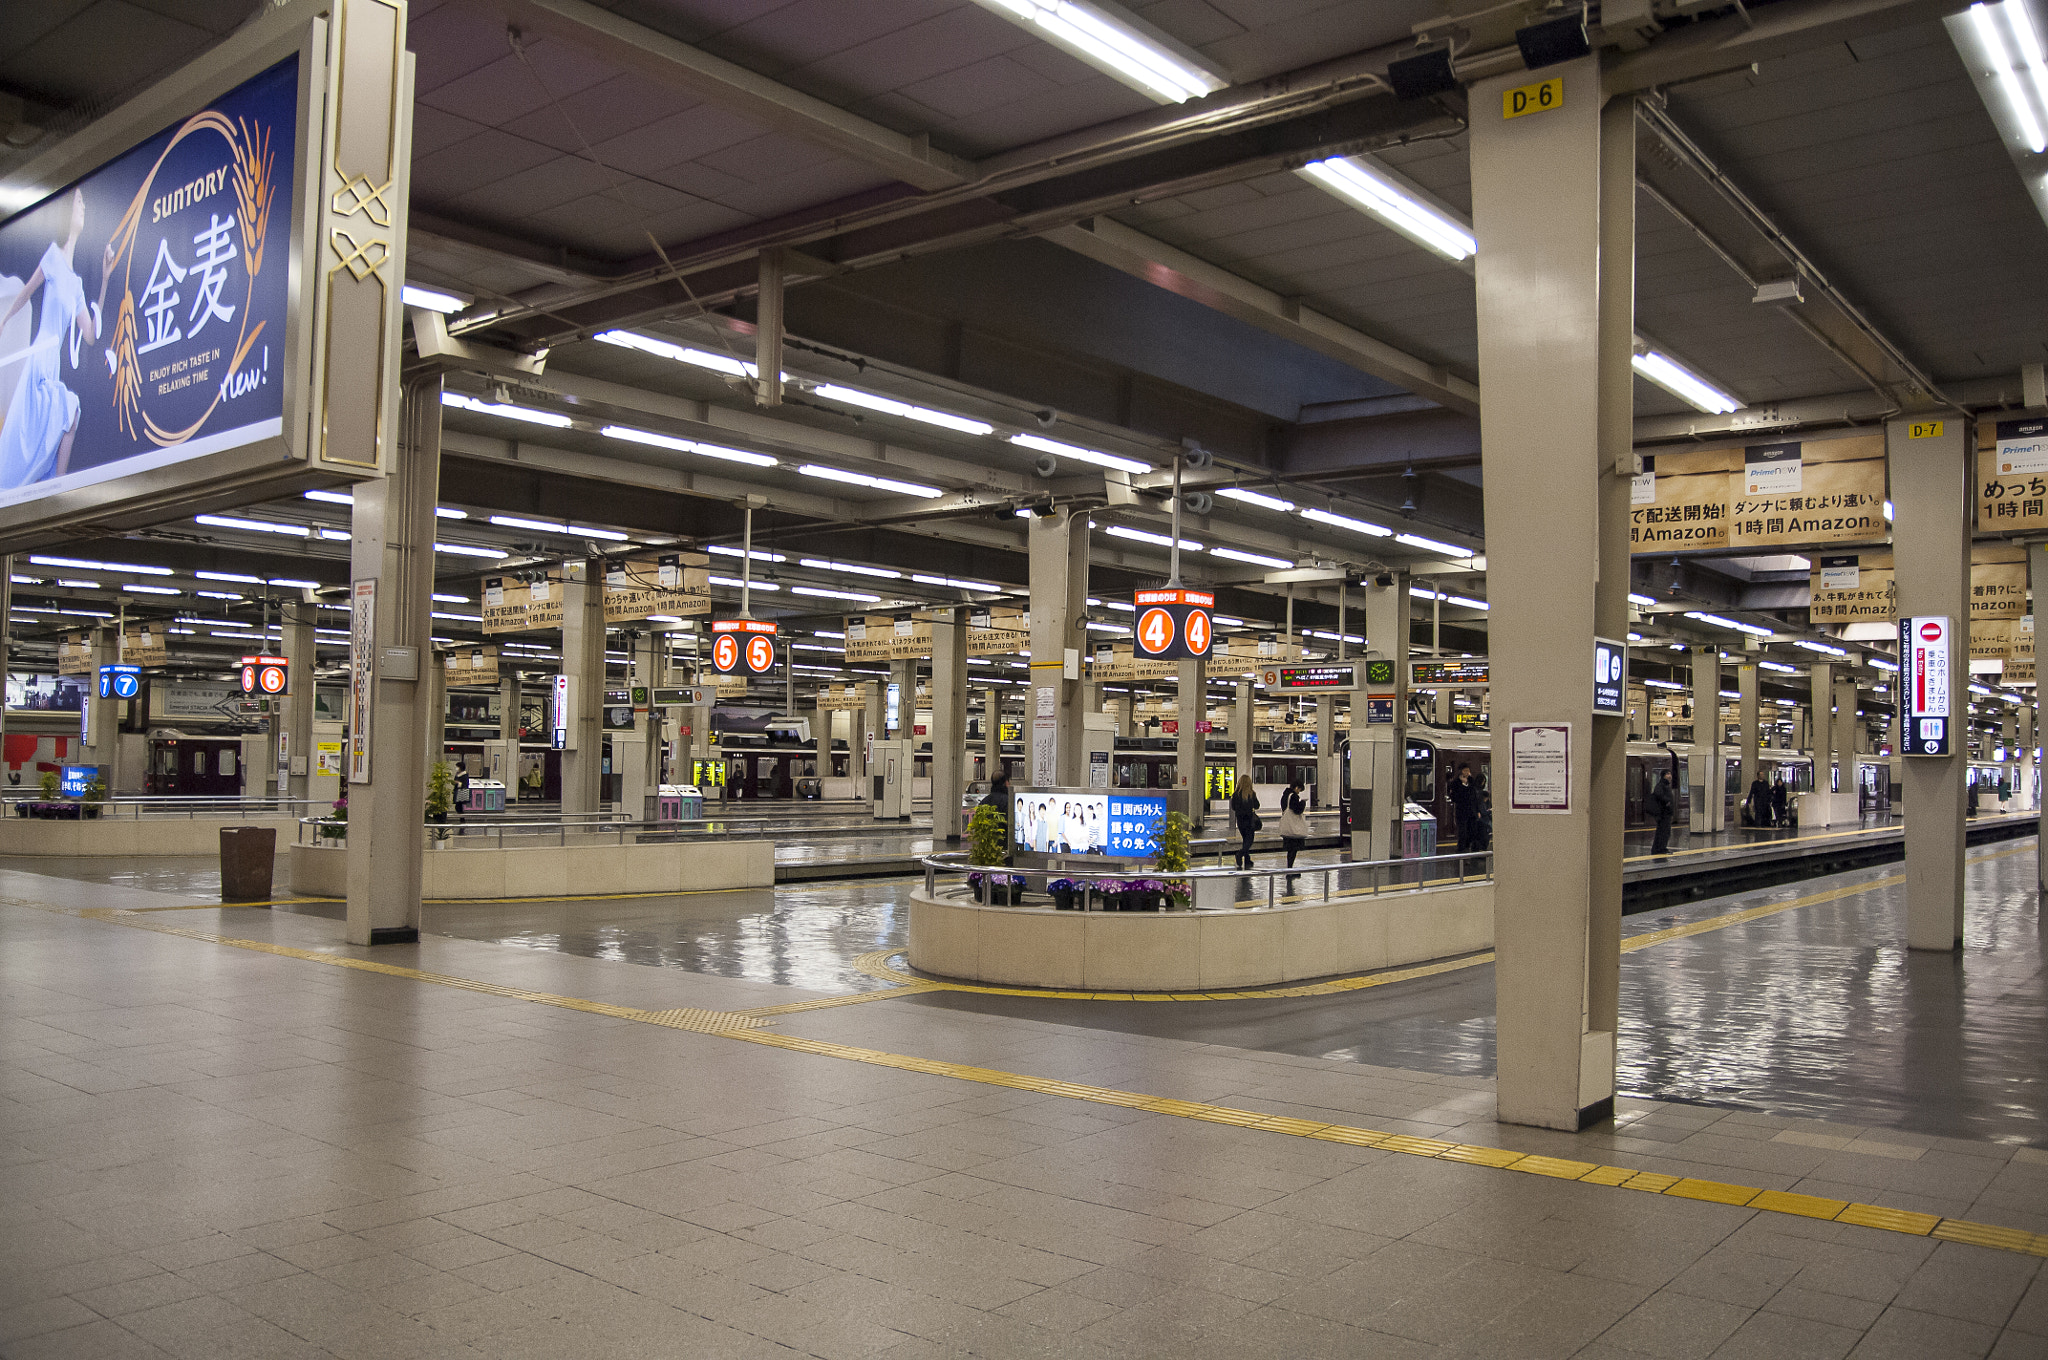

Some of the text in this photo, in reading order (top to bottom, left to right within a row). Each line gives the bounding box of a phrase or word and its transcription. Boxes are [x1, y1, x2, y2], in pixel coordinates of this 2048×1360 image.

[1513, 84, 1552, 113] D-6
[152, 165, 228, 224] SUNTORY
[138, 213, 238, 355] 金麦
[150, 348, 220, 382] ENJOY RICH TASTE IN
[158, 369, 209, 396] RELAXING TIME
[1914, 423, 1937, 437] D-7
[1984, 477, 2047, 499] めっち
[1735, 494, 1880, 515] ダンナに頼むより速い。
[1145, 614, 1166, 647] 4
[1190, 616, 1204, 648] 4
[719, 640, 732, 666] 5
[752, 640, 766, 668] 5
[1918, 650, 1924, 658] No
[120, 678, 132, 694] 7
[245, 669, 252, 689] 6
[265, 669, 280, 690] 6
[1937, 650, 1946, 714] このホームから
[1123, 803, 1162, 816] 関西外大
